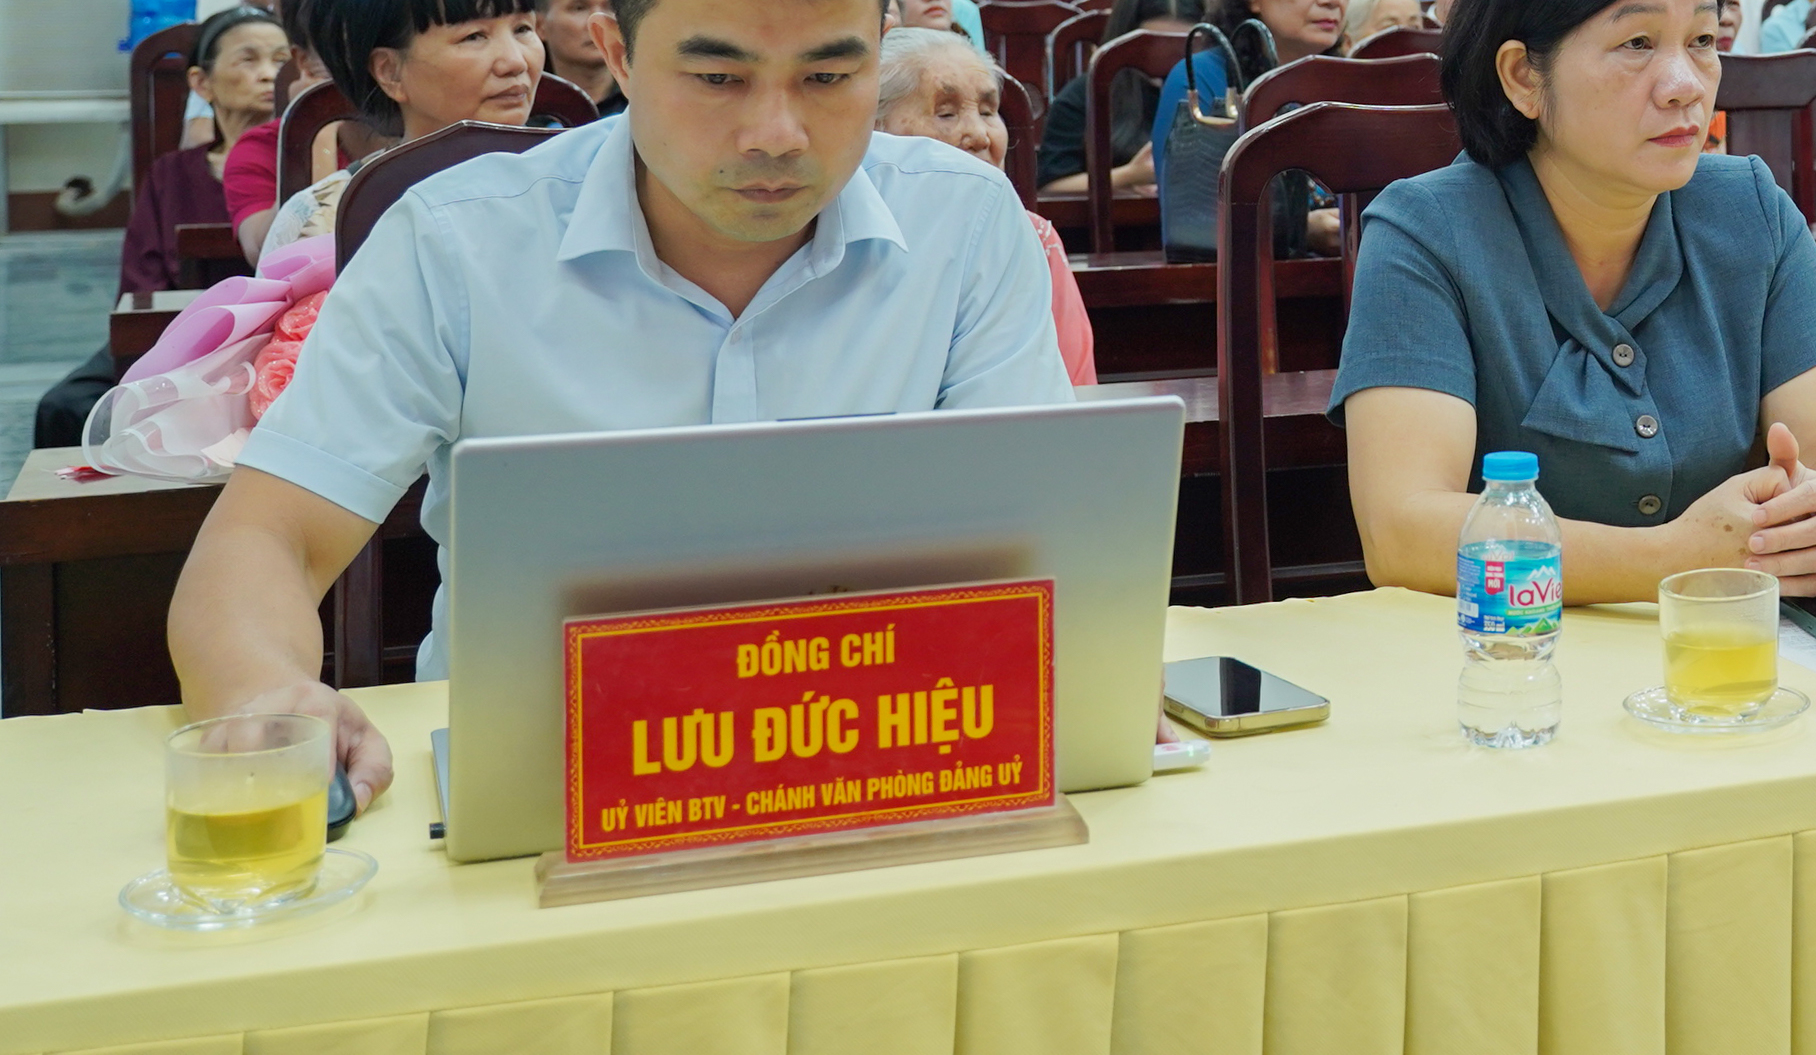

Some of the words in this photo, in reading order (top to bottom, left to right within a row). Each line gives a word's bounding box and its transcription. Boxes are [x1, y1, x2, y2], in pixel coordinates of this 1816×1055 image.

[1508, 576, 1562, 607] laVie
[737, 630, 830, 678] ĐỒNG
[840, 624, 895, 667] CHÍ
[633, 708, 734, 776] LƯU
[752, 691, 859, 763] ĐỨC
[878, 677, 994, 754] HIỆU
[602, 799, 627, 832] UỶ
[635, 797, 683, 828] VIÊN
[688, 795, 726, 822] BTV
[746, 784, 815, 816] CHÁNH
[822, 776, 862, 805] VĂN
[868, 770, 934, 802] PHÒNG
[940, 761, 992, 792] ĐẢNG
[998, 755, 1023, 784] UỶ
